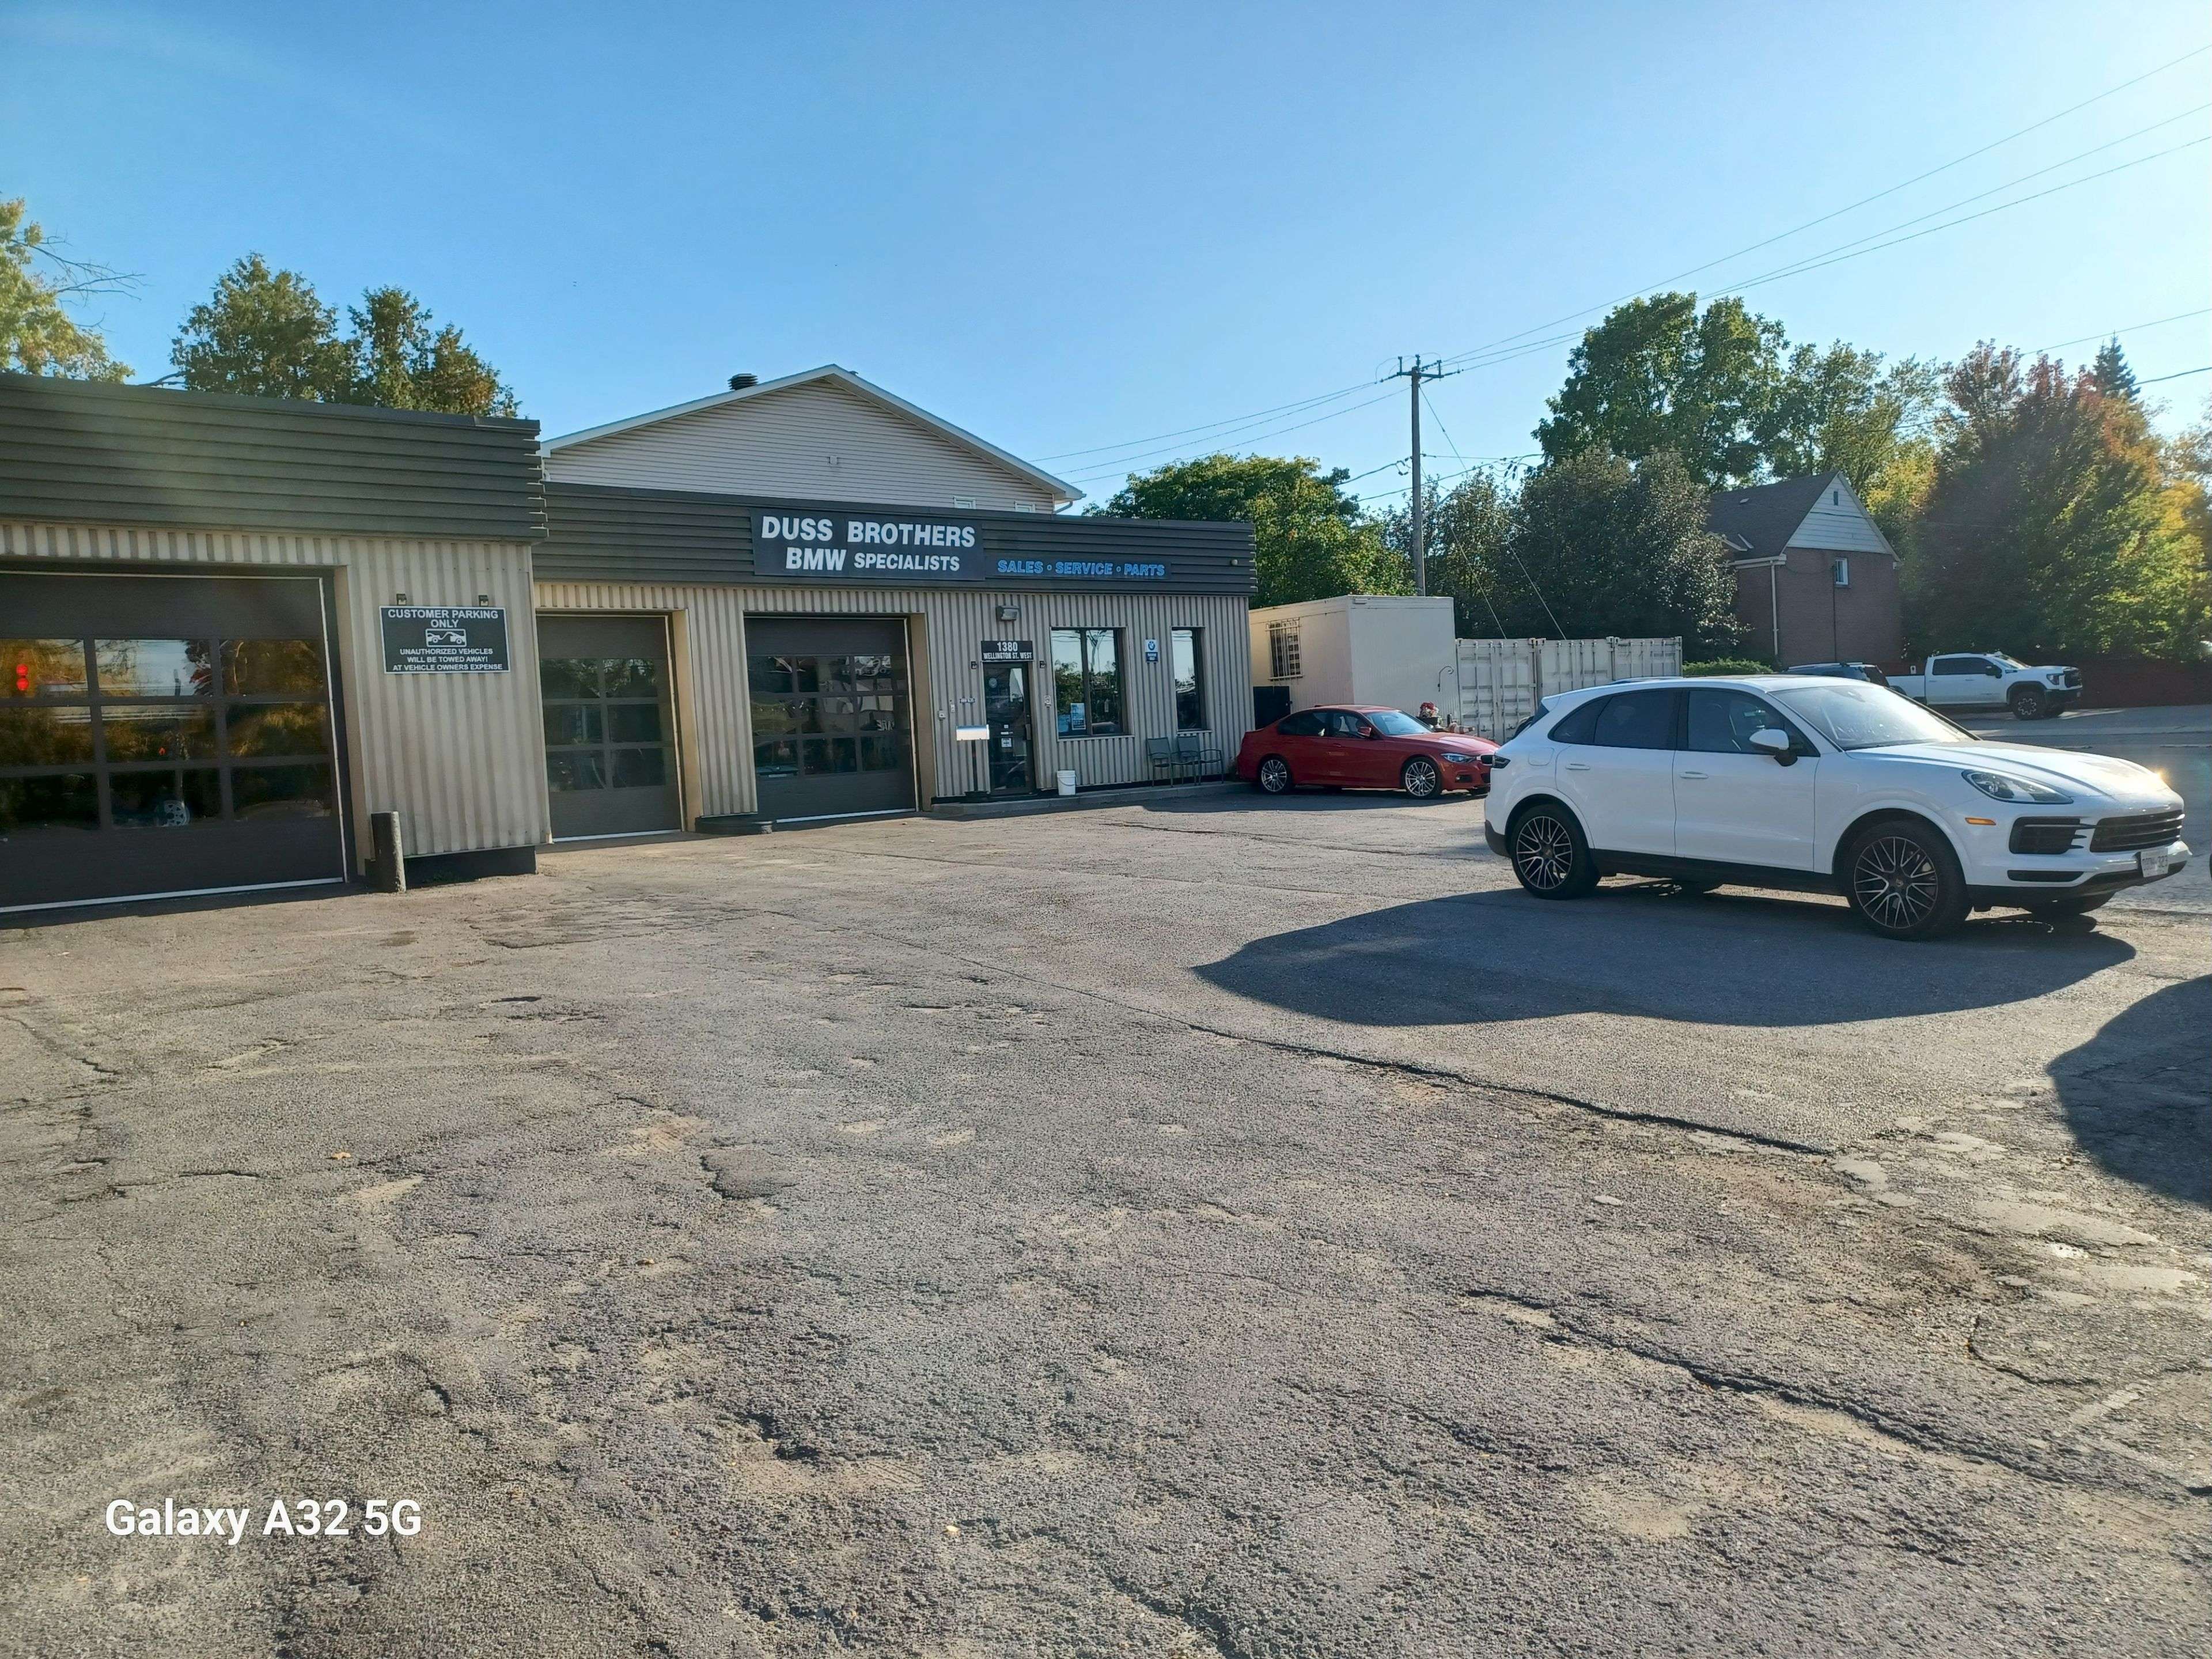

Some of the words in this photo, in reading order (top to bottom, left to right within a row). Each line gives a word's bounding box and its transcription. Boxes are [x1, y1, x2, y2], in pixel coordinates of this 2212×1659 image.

[761, 516, 833, 541] DUSS
[847, 521, 975, 548] BROTHERS
[786, 547, 847, 571] BMW
[853, 552, 960, 571] SPECIALISTS
[997, 560, 1043, 574] SALES
[1055, 562, 1113, 575] SERVICE
[1124, 563, 1165, 577] PARTS
[388, 609, 449, 619] CUSTOMER
[452, 609, 498, 619] PARKING
[430, 619, 459, 628] ONLY
[997, 642, 1018, 652] 1380
